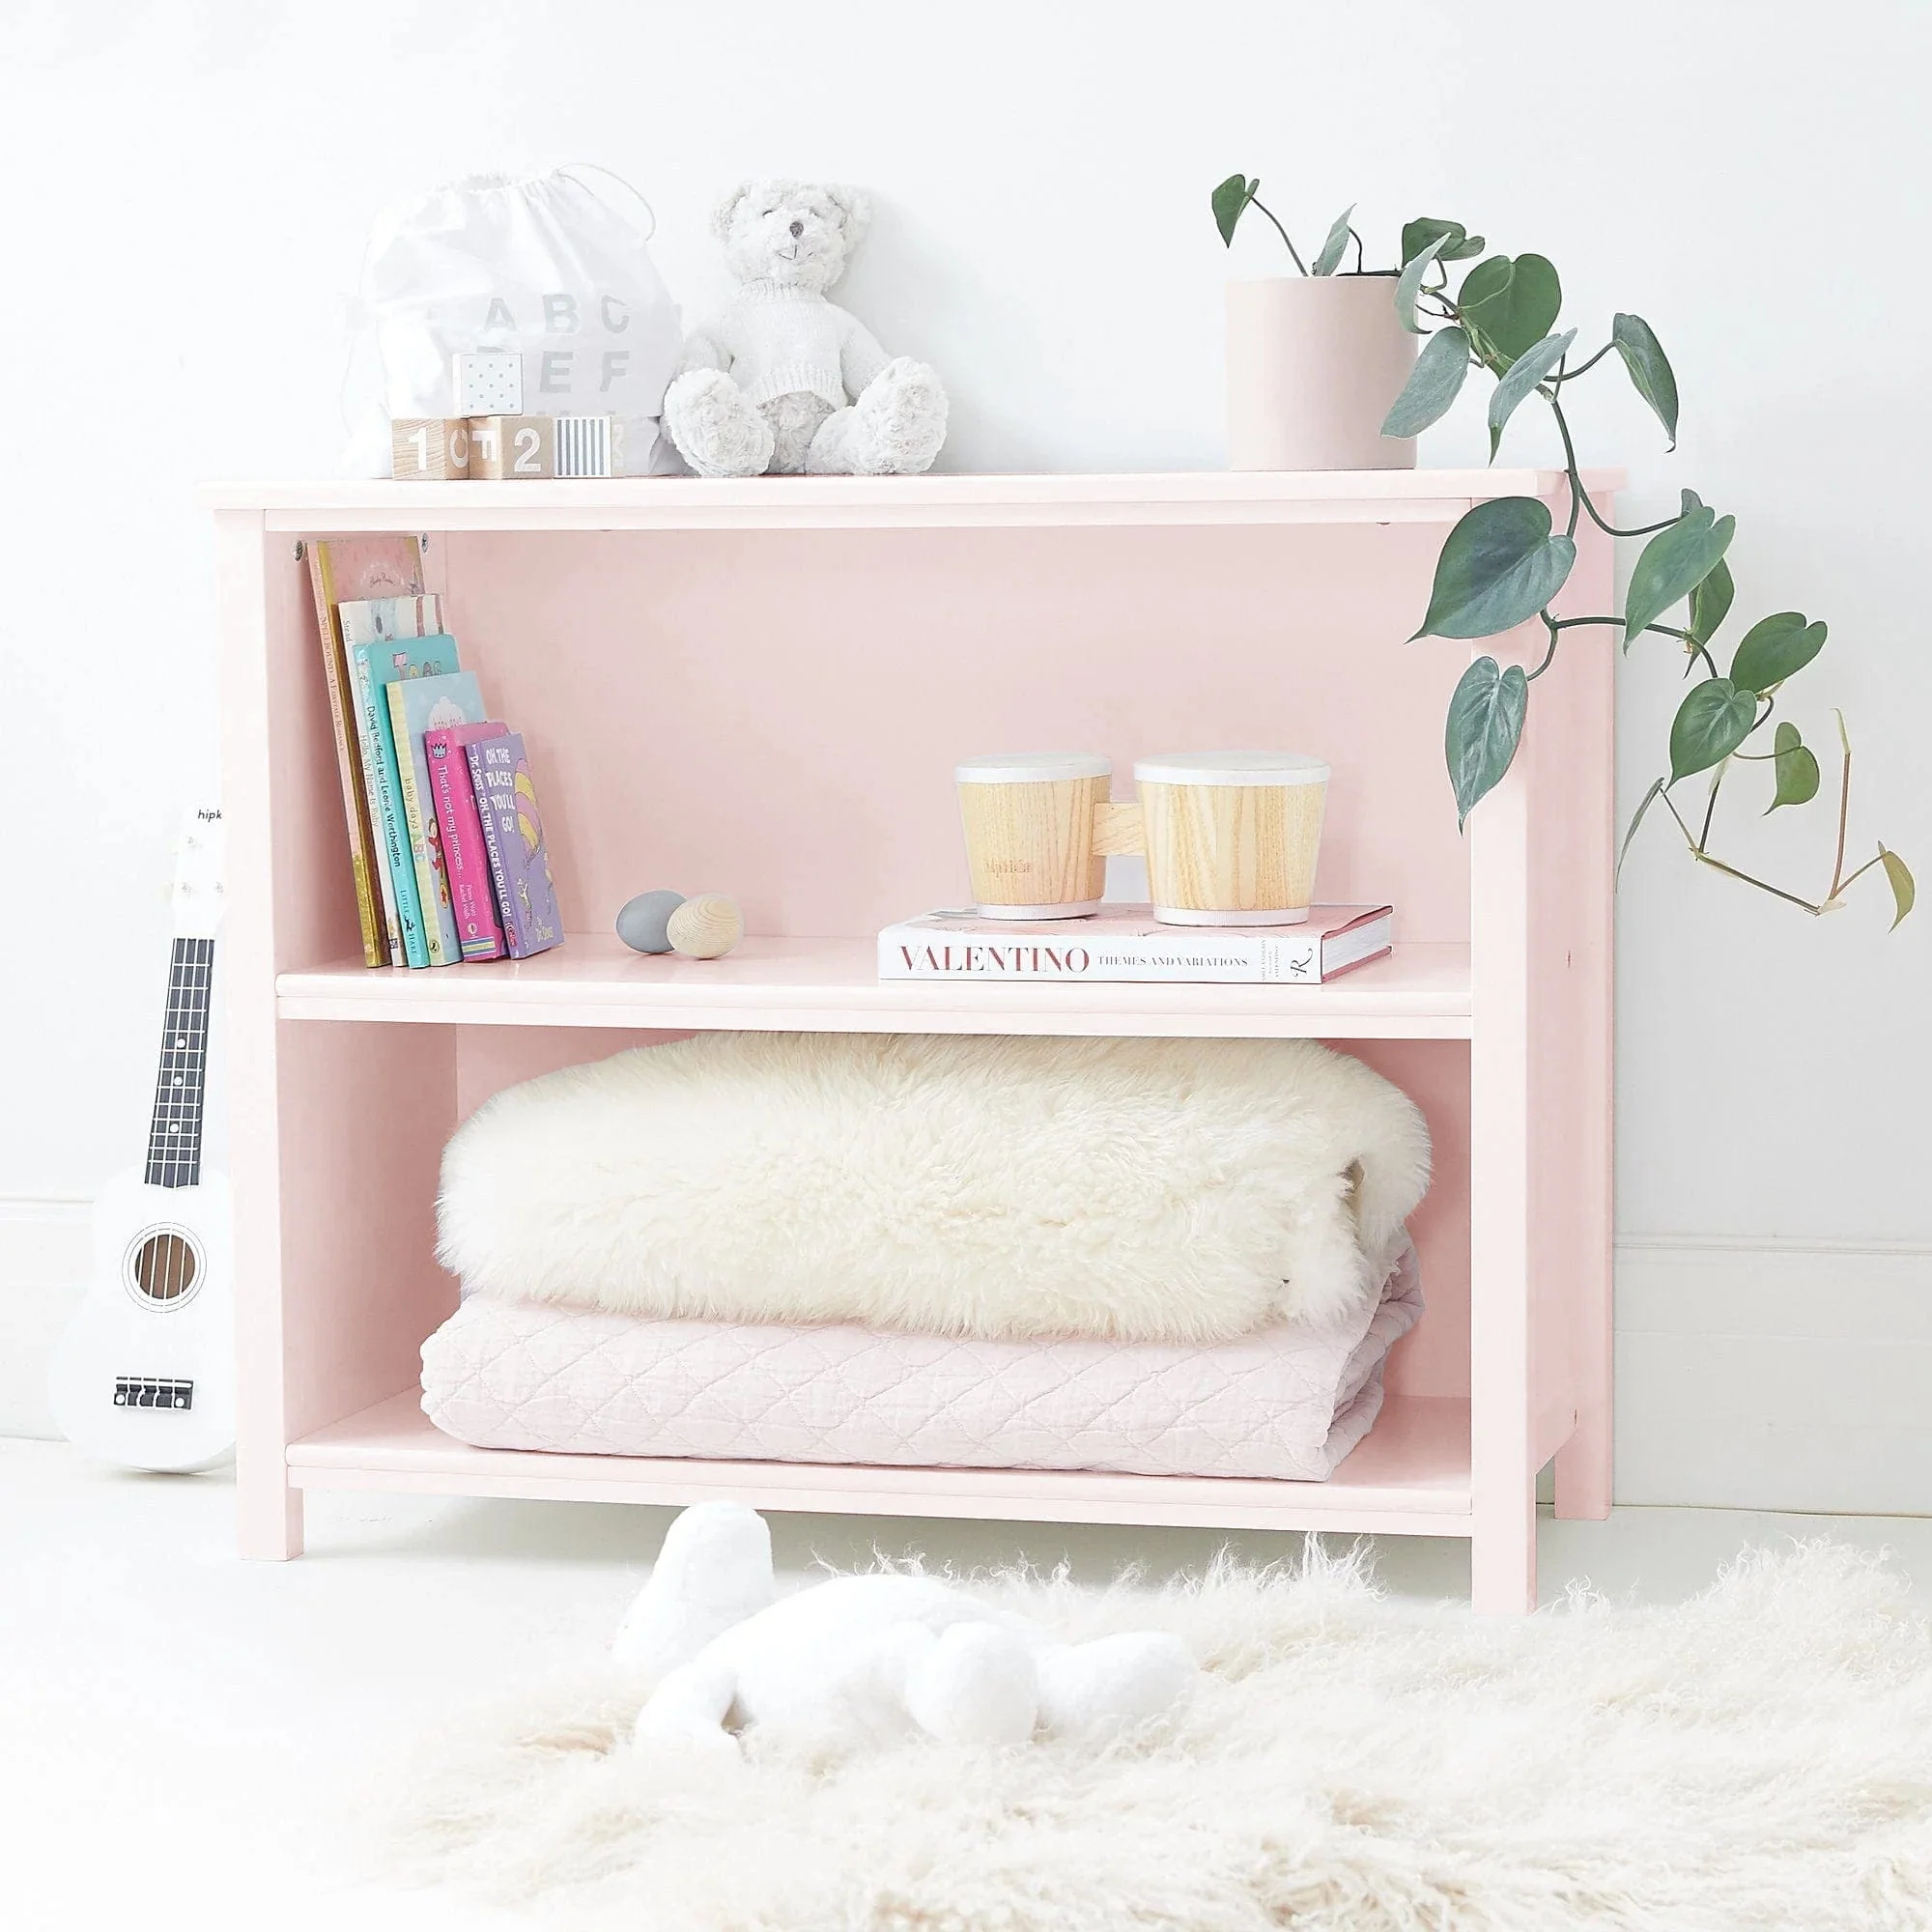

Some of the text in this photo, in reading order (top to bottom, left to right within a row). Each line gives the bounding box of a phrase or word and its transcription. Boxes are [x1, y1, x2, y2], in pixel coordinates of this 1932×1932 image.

[484, 298, 518, 332] A
[542, 294, 580, 334] B
[409, 426, 427, 470] 1
[514, 427, 542, 472] 2
[343, 620, 353, 642] Stead
[365, 773, 375, 795] Name
[367, 706, 401, 867] David Bedford and Leonie Worthington
[437, 765, 452, 793] That's
[472, 769, 484, 790] Seuss
[485, 771, 513, 787] PLACES
[405, 779, 414, 803] baby
[410, 808, 418, 830] days
[443, 796, 455, 813] not
[446, 816, 457, 833] my
[483, 813, 494, 834] THE
[487, 834, 501, 867] PLACES
[501, 901, 513, 917] GO!
[899, 946, 1248, 973] VALENTINO THEMES AND VARIATIONS
